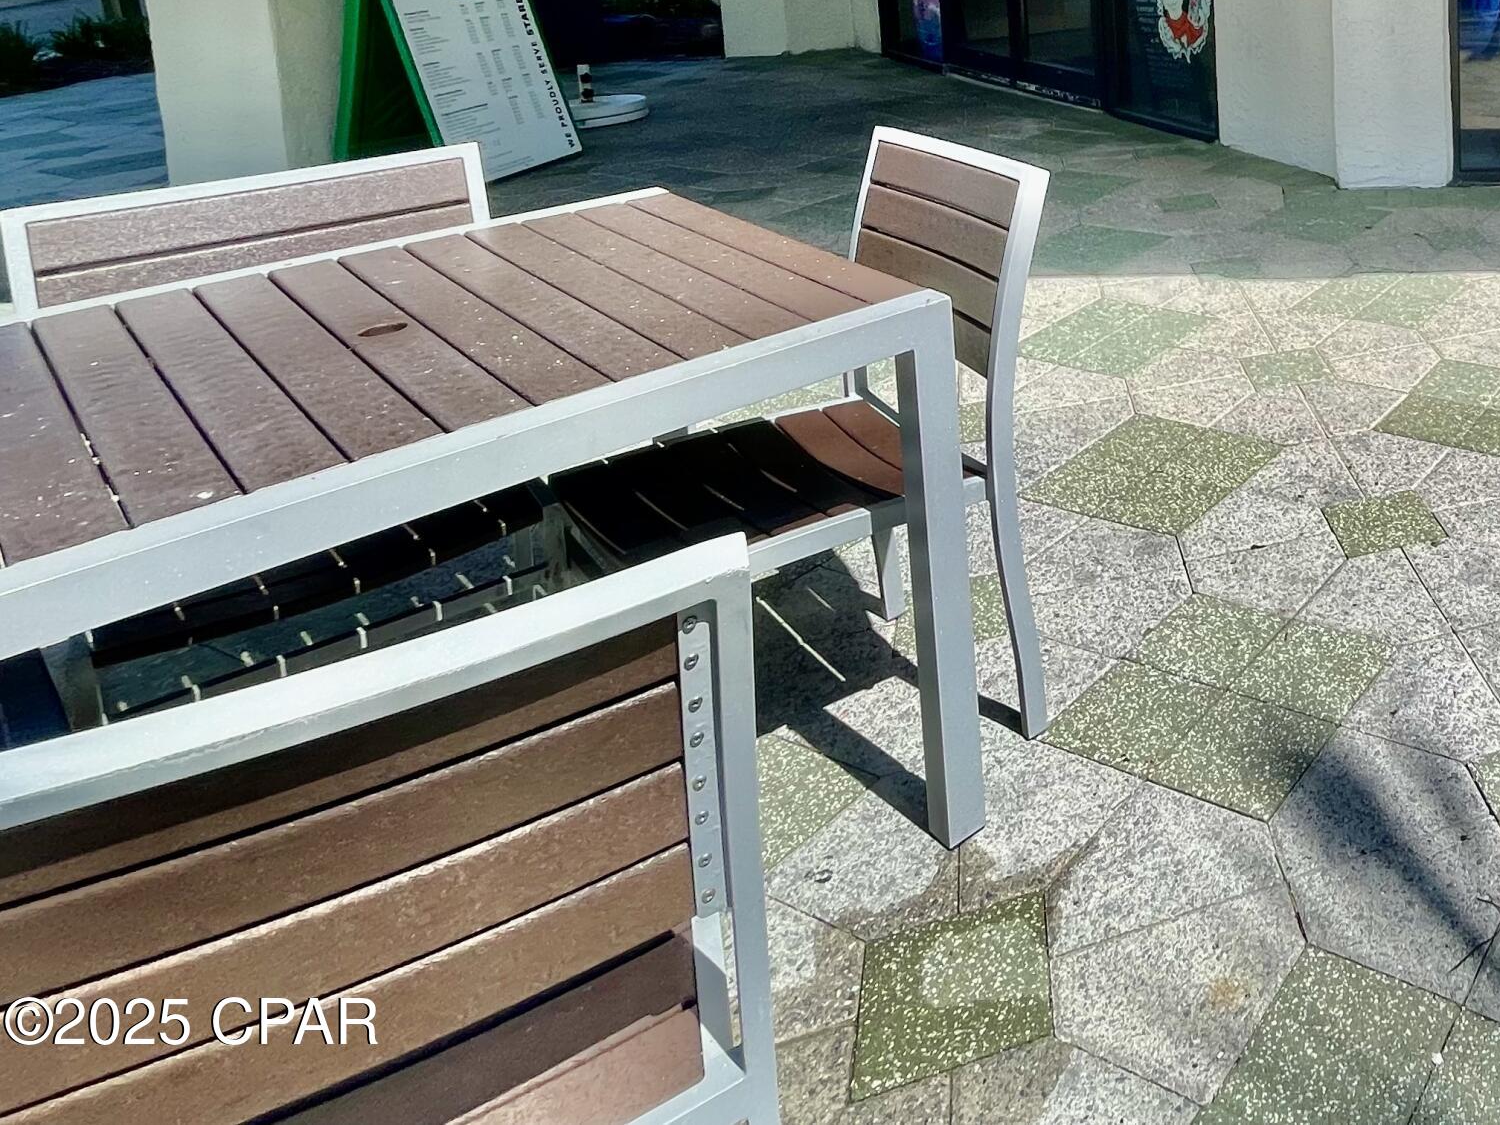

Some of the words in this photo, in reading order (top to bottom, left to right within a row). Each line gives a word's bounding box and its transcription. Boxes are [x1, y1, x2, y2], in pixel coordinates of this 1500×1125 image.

[531, 41, 548, 75] SERVE
[544, 79, 568, 128] PROUDLY
[565, 133, 575, 148] WE
